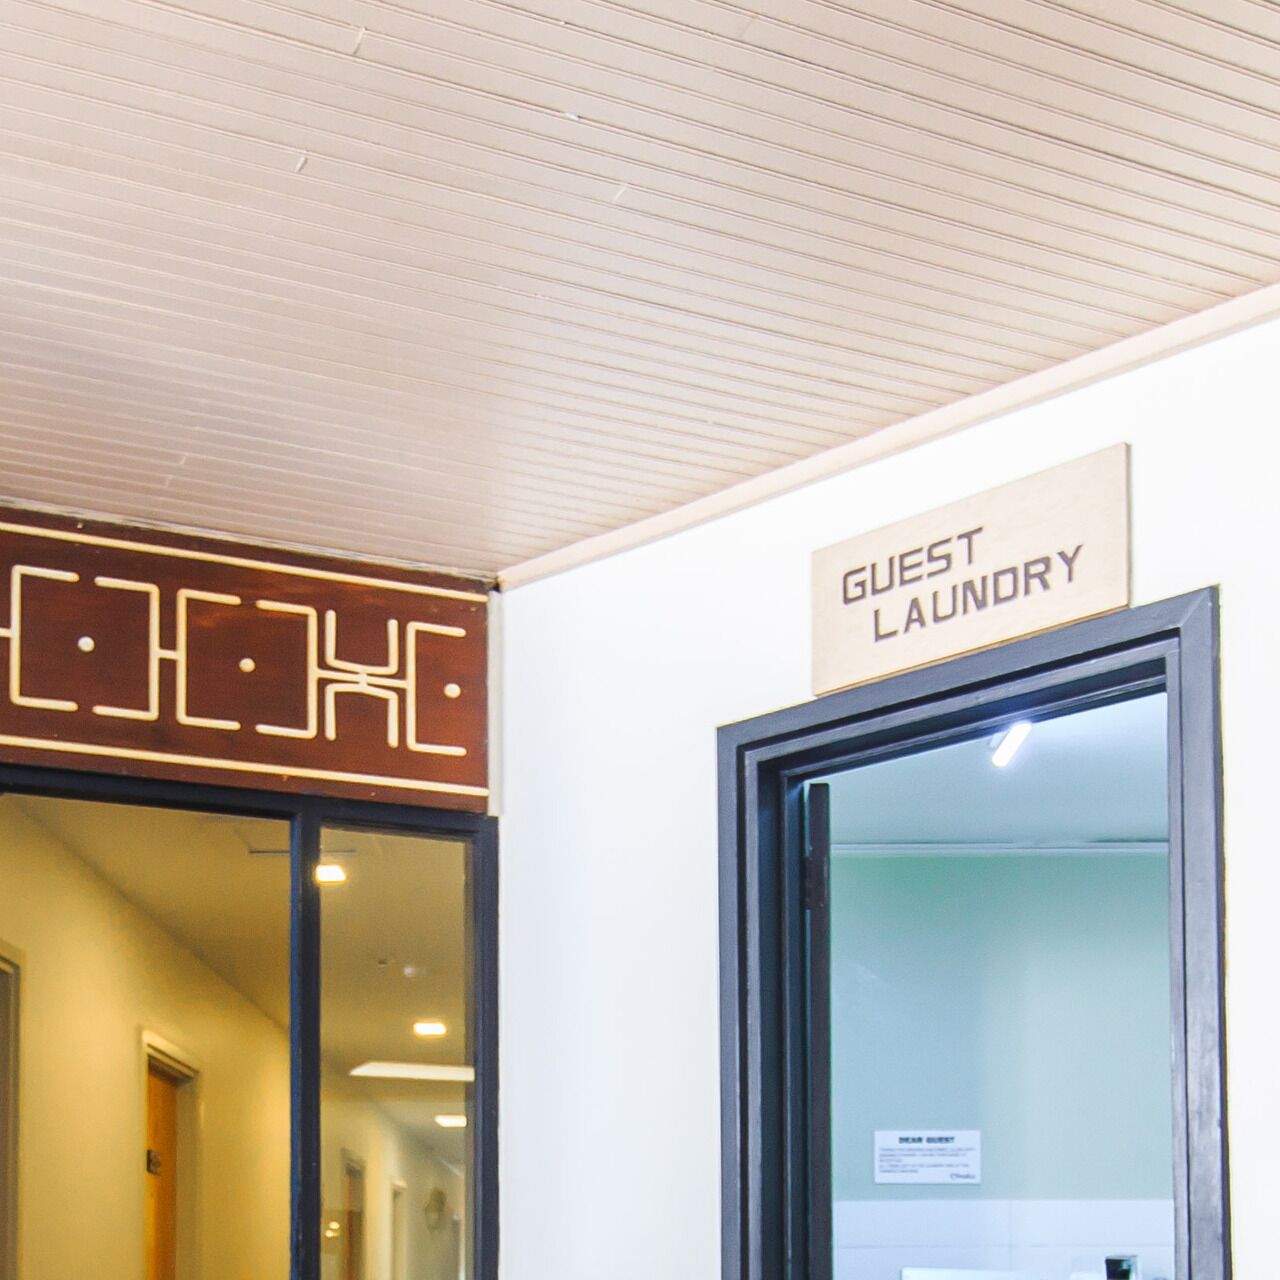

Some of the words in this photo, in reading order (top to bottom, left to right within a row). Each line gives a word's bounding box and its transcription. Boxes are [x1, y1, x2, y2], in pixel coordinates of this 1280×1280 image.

[842, 527, 984, 605] GUEST
[873, 544, 1084, 643] LAUNDRY
[898, 1136, 923, 1144] DEAR
[926, 1136, 955, 1144] GUEST
